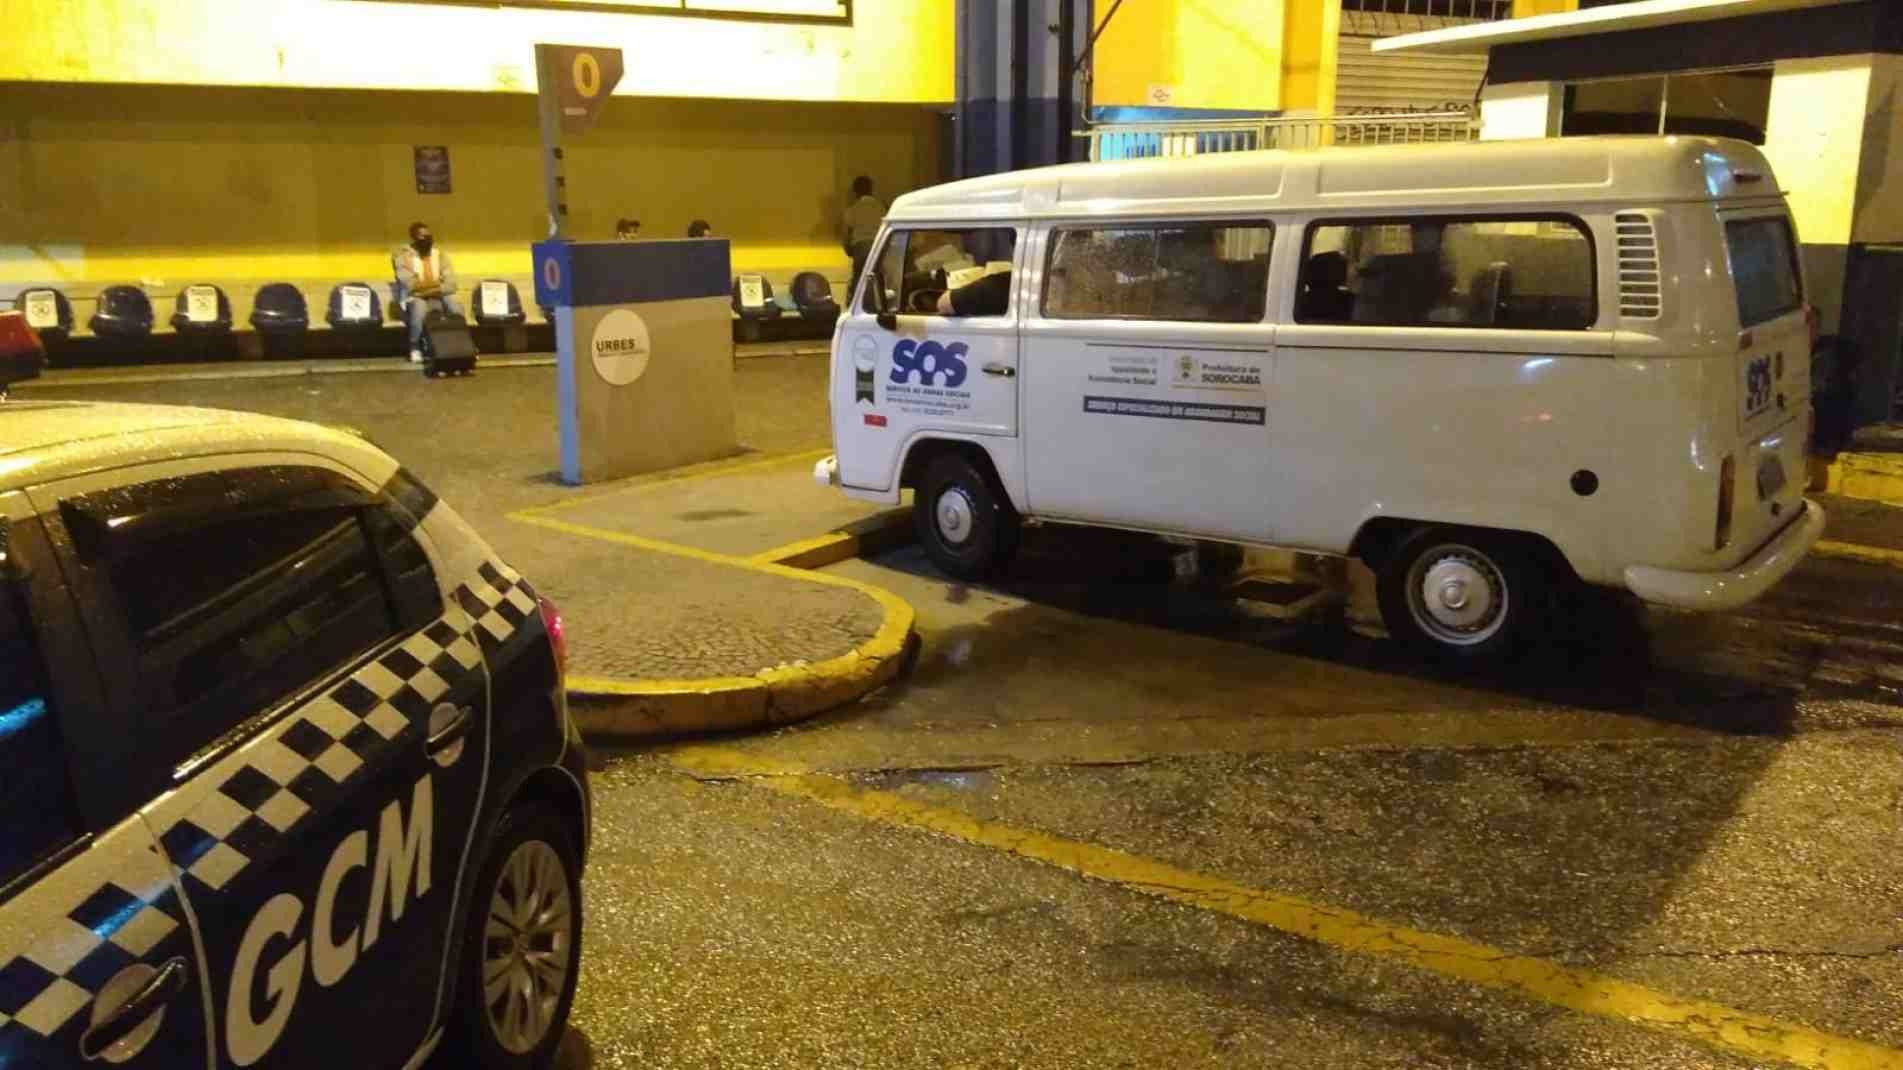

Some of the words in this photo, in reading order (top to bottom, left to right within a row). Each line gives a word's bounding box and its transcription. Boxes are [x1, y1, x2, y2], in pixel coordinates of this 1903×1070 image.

[595, 338, 636, 352] URBES
[889, 338, 970, 388] SOS
[1201, 373, 1261, 385] SOROCABA
[226, 772, 434, 1067] GCM
